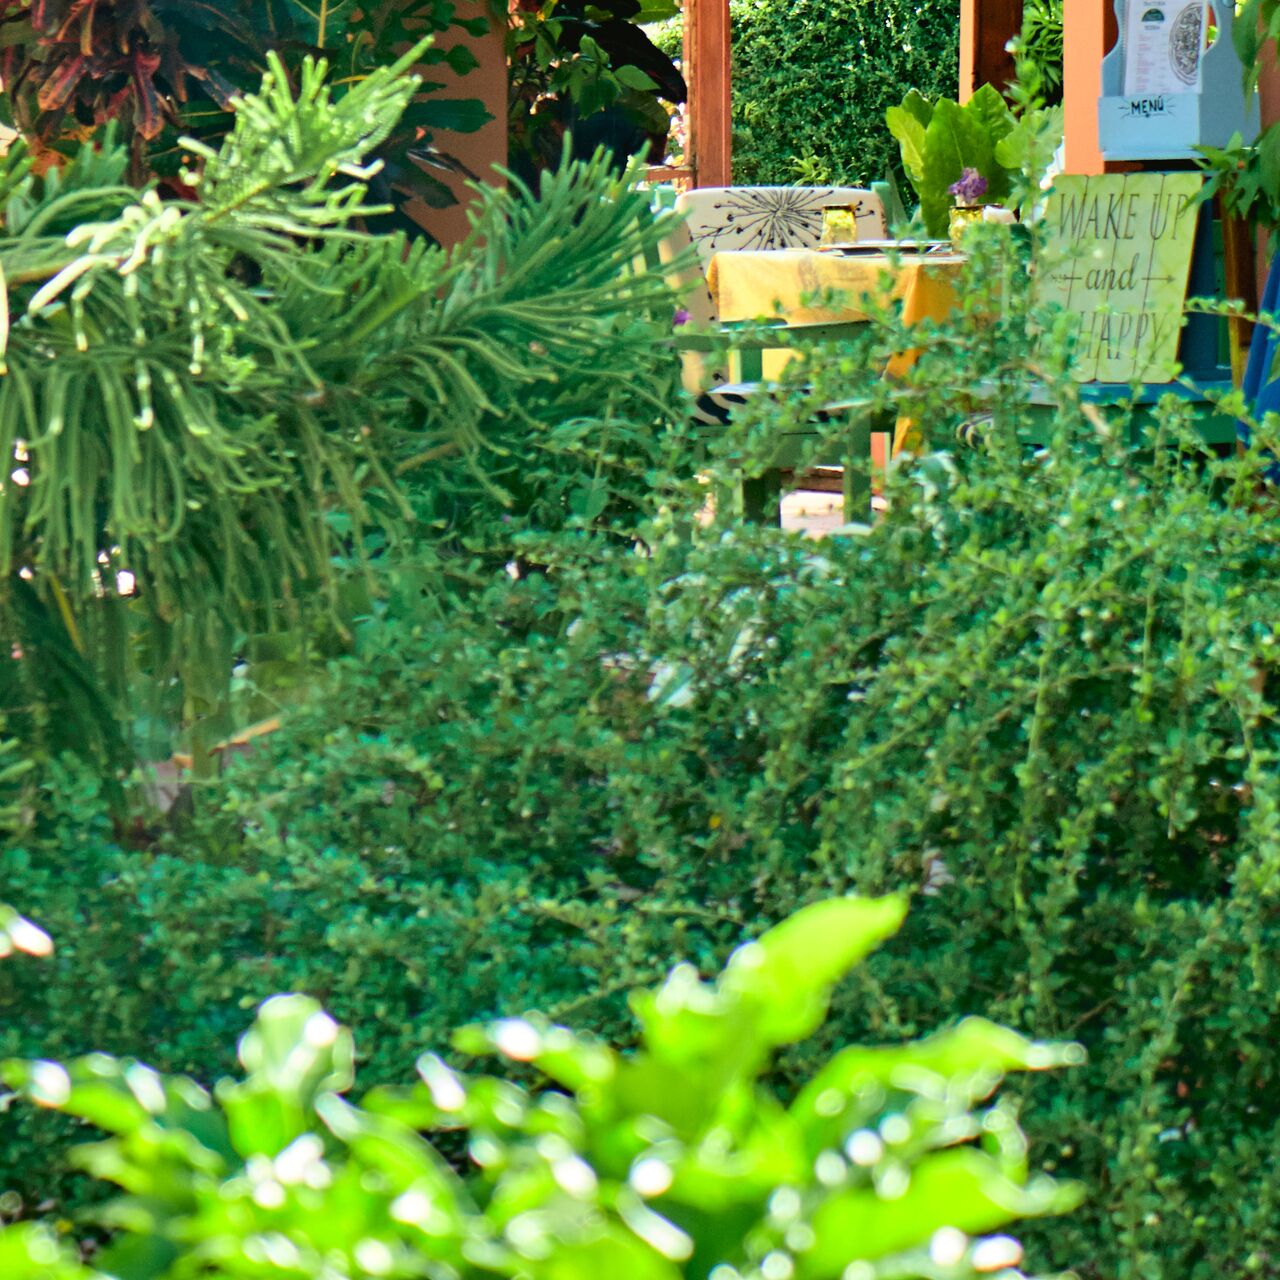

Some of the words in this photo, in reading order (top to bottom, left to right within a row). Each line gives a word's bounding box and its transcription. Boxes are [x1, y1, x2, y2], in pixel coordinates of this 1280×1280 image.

[1131, 95, 1164, 115] MENÚ
[1058, 192, 1140, 240] WAKE
[1150, 193, 1188, 240] UP
[1085, 252, 1140, 290] and
[1075, 311, 1168, 360] HAPPY
